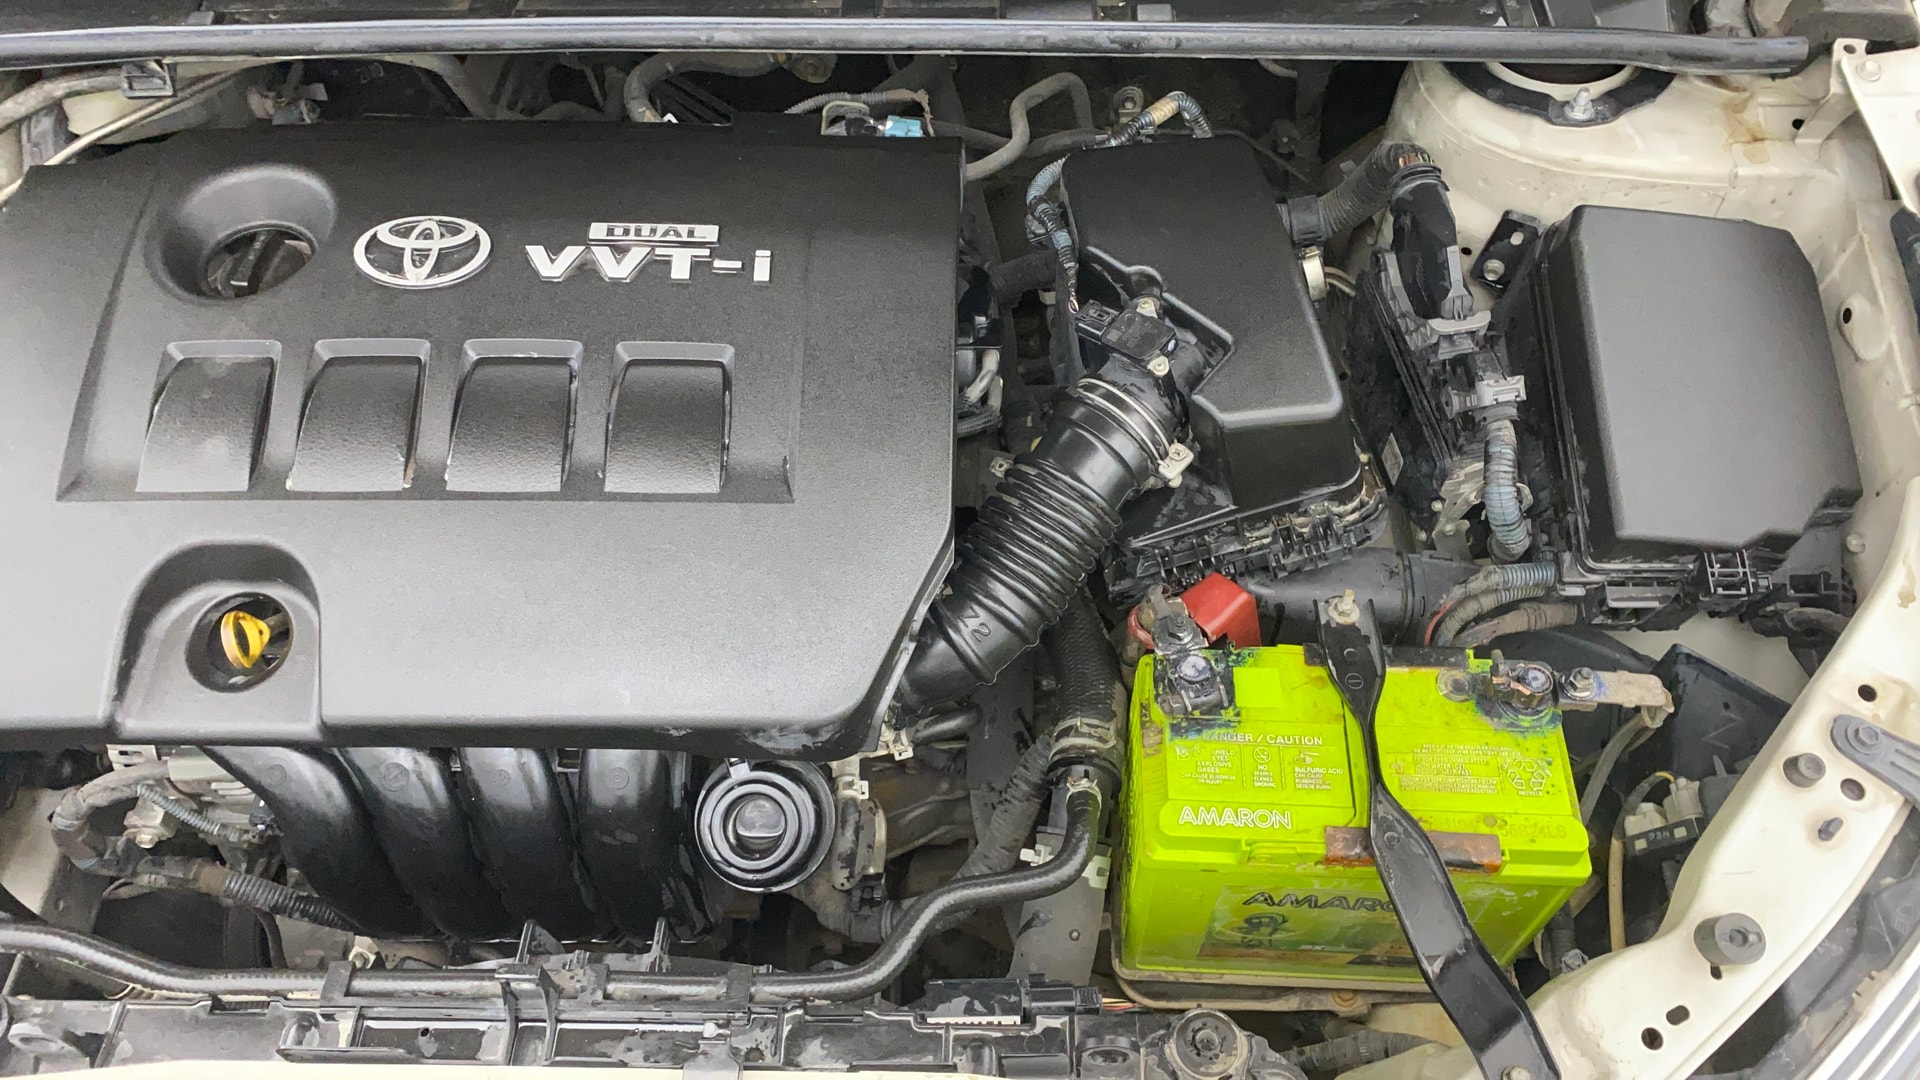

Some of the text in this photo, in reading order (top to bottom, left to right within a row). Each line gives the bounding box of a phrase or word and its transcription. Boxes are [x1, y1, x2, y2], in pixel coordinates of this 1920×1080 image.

[606, 224, 707, 239] DUAL
[525, 245, 772, 283] VVT-i
[1266, 734, 1323, 745] CAUTION
[1178, 806, 1292, 829] AMARON
